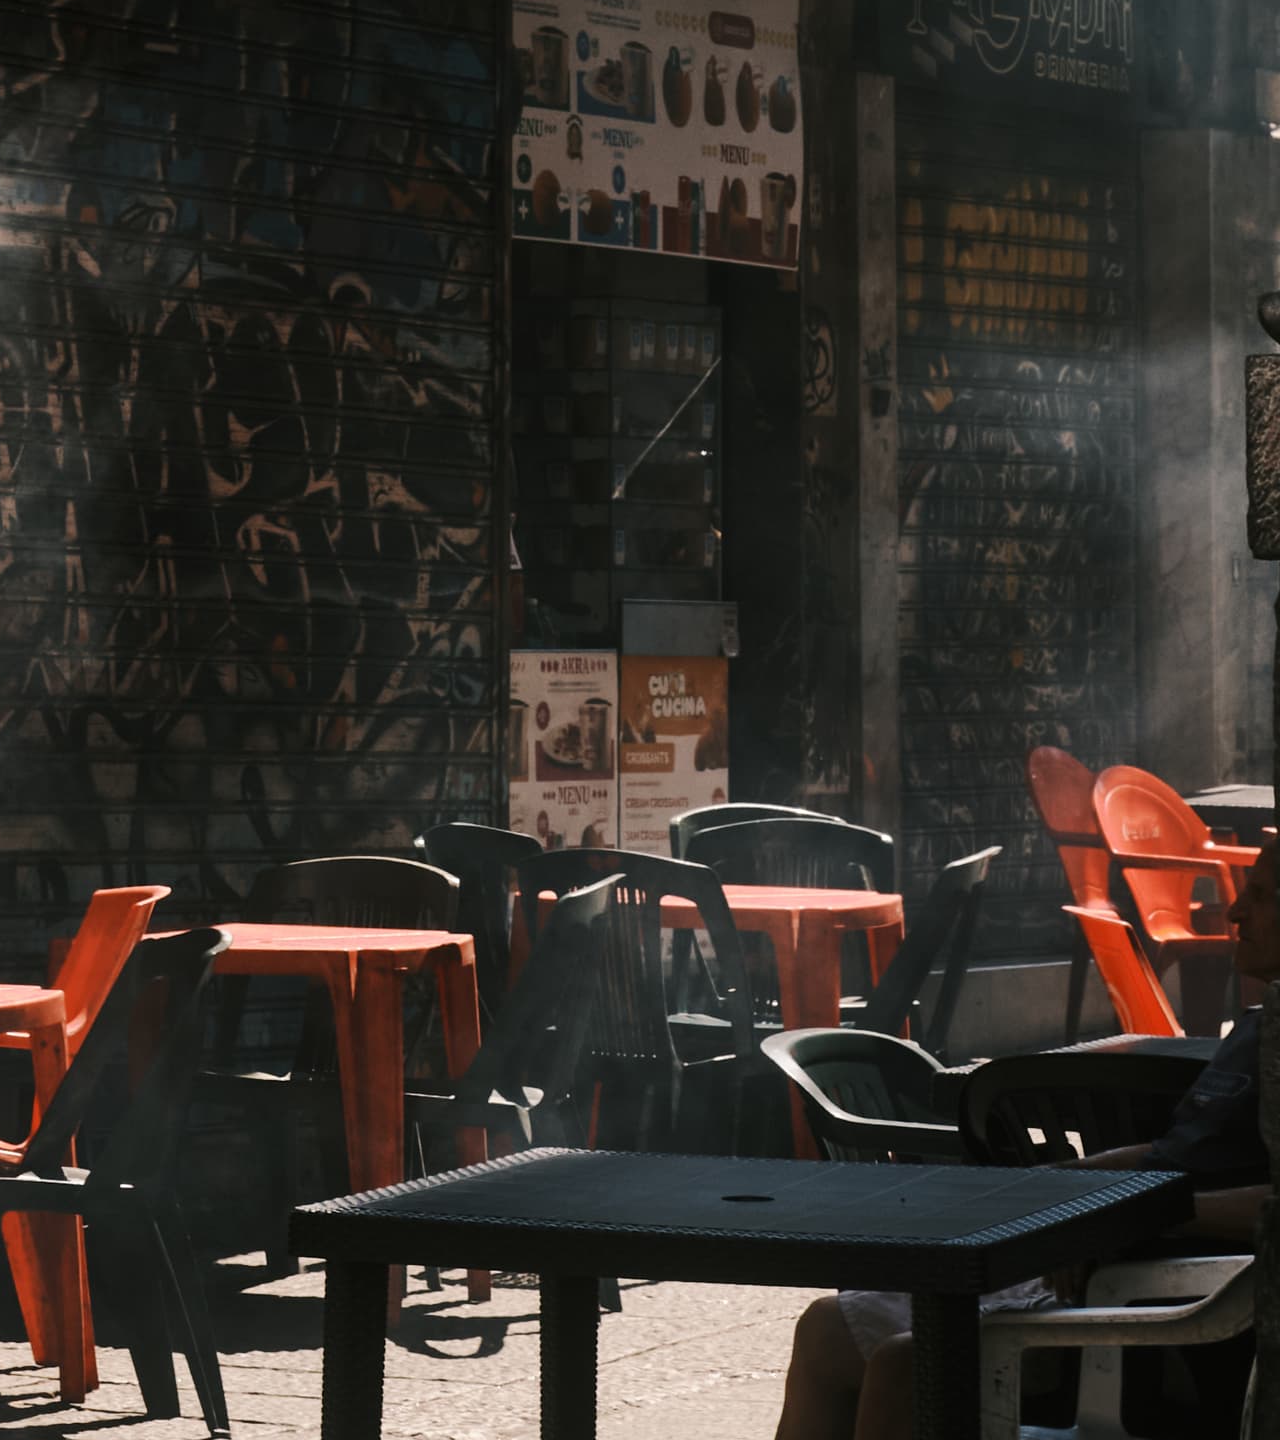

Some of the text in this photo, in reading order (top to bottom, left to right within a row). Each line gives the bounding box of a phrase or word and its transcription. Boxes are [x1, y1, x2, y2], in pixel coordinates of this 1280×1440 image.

[602, 127, 635, 149] MENU
[719, 143, 751, 166] MENU
[651, 695, 707, 720] CUCINA
[557, 785, 590, 806] MENU
